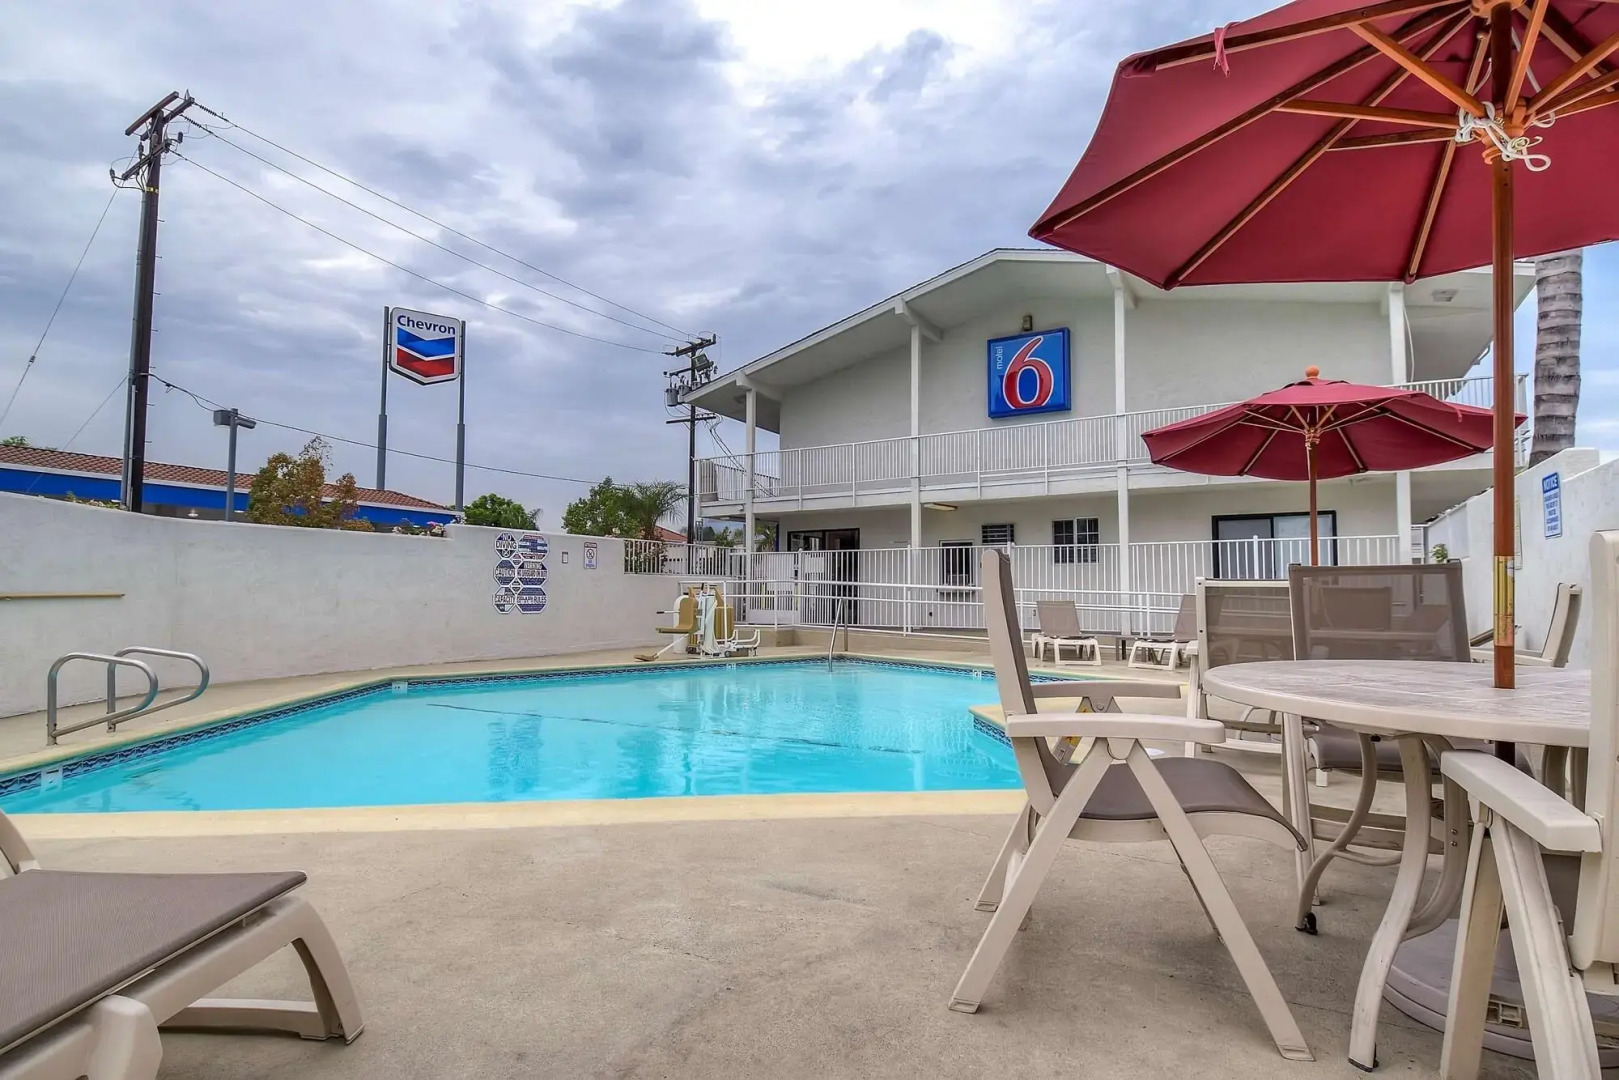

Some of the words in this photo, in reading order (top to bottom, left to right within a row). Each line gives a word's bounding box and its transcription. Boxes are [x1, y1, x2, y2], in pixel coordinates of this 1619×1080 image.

[397, 315, 456, 335] Chevron
[995, 346, 1003, 370] motel
[1002, 336, 1055, 409] 6
[502, 533, 511, 541] NO
[496, 541, 516, 549] DIVING
[495, 569, 515, 577] CAUTION
[495, 596, 515, 604] CAPACITY
